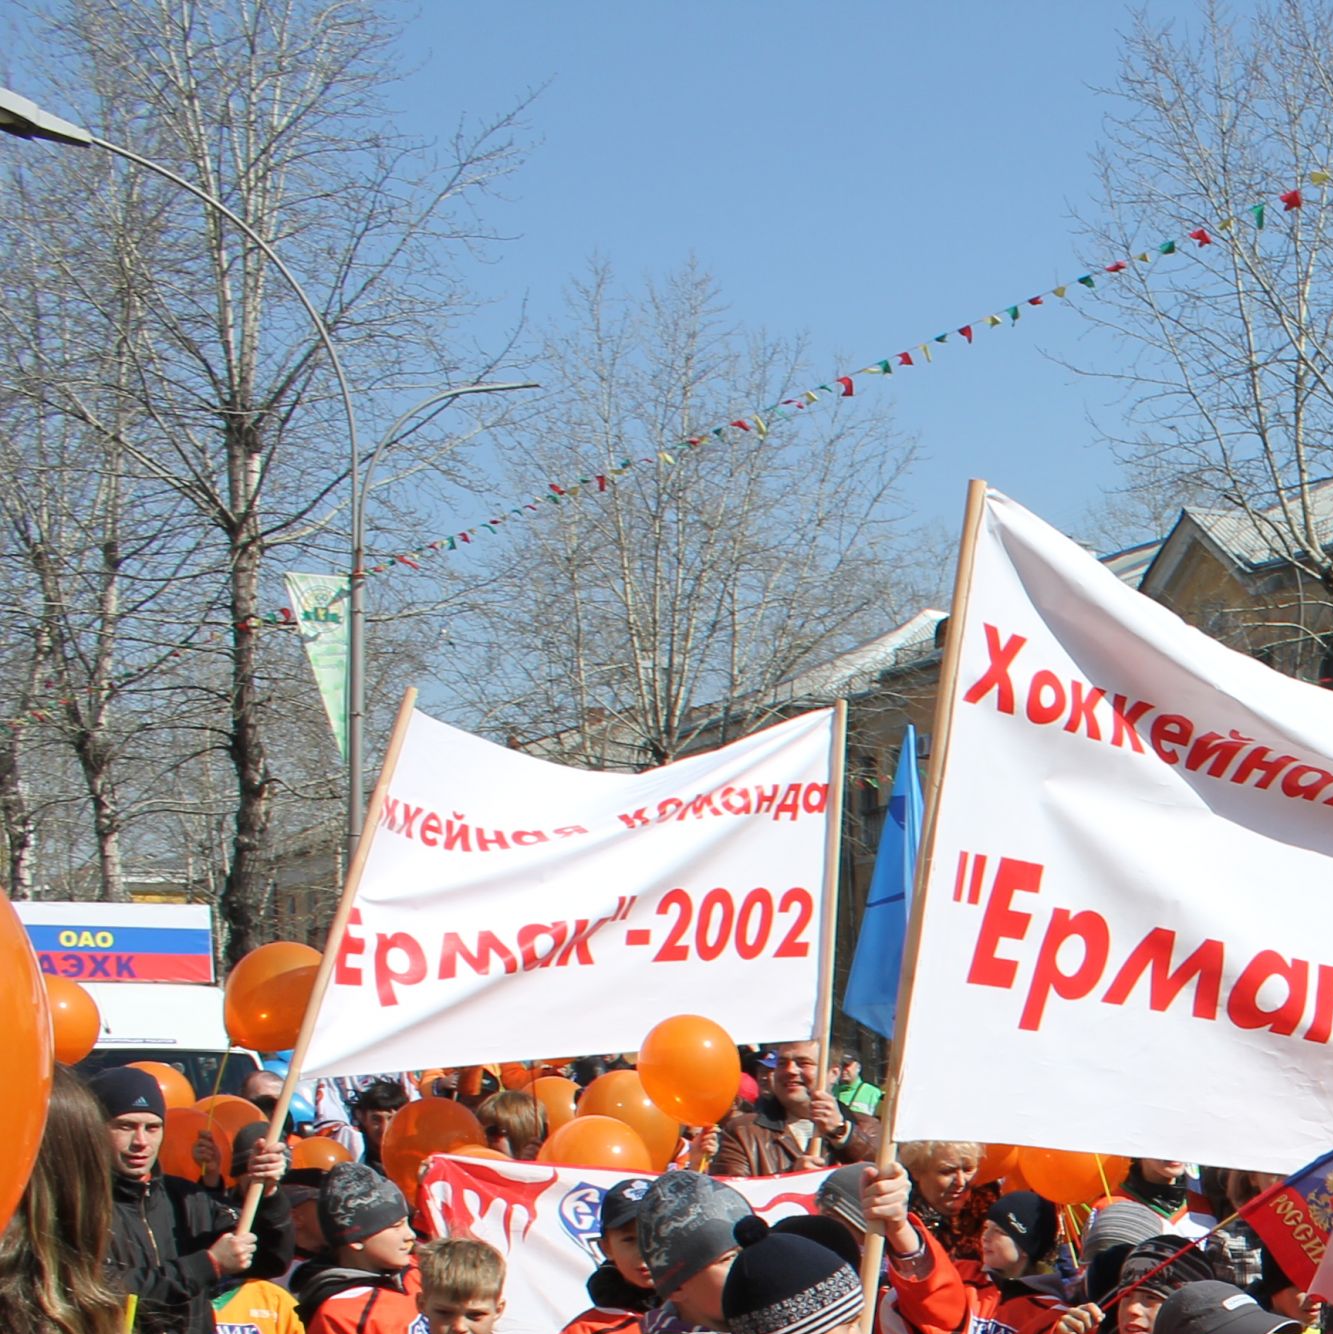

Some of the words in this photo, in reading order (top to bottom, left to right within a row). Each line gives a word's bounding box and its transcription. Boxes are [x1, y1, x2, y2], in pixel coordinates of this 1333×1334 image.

[58, 930, 114, 949] ОАО
[40, 954, 137, 979] АЭХК
[1269, 1194, 1328, 1264] РОССИ
